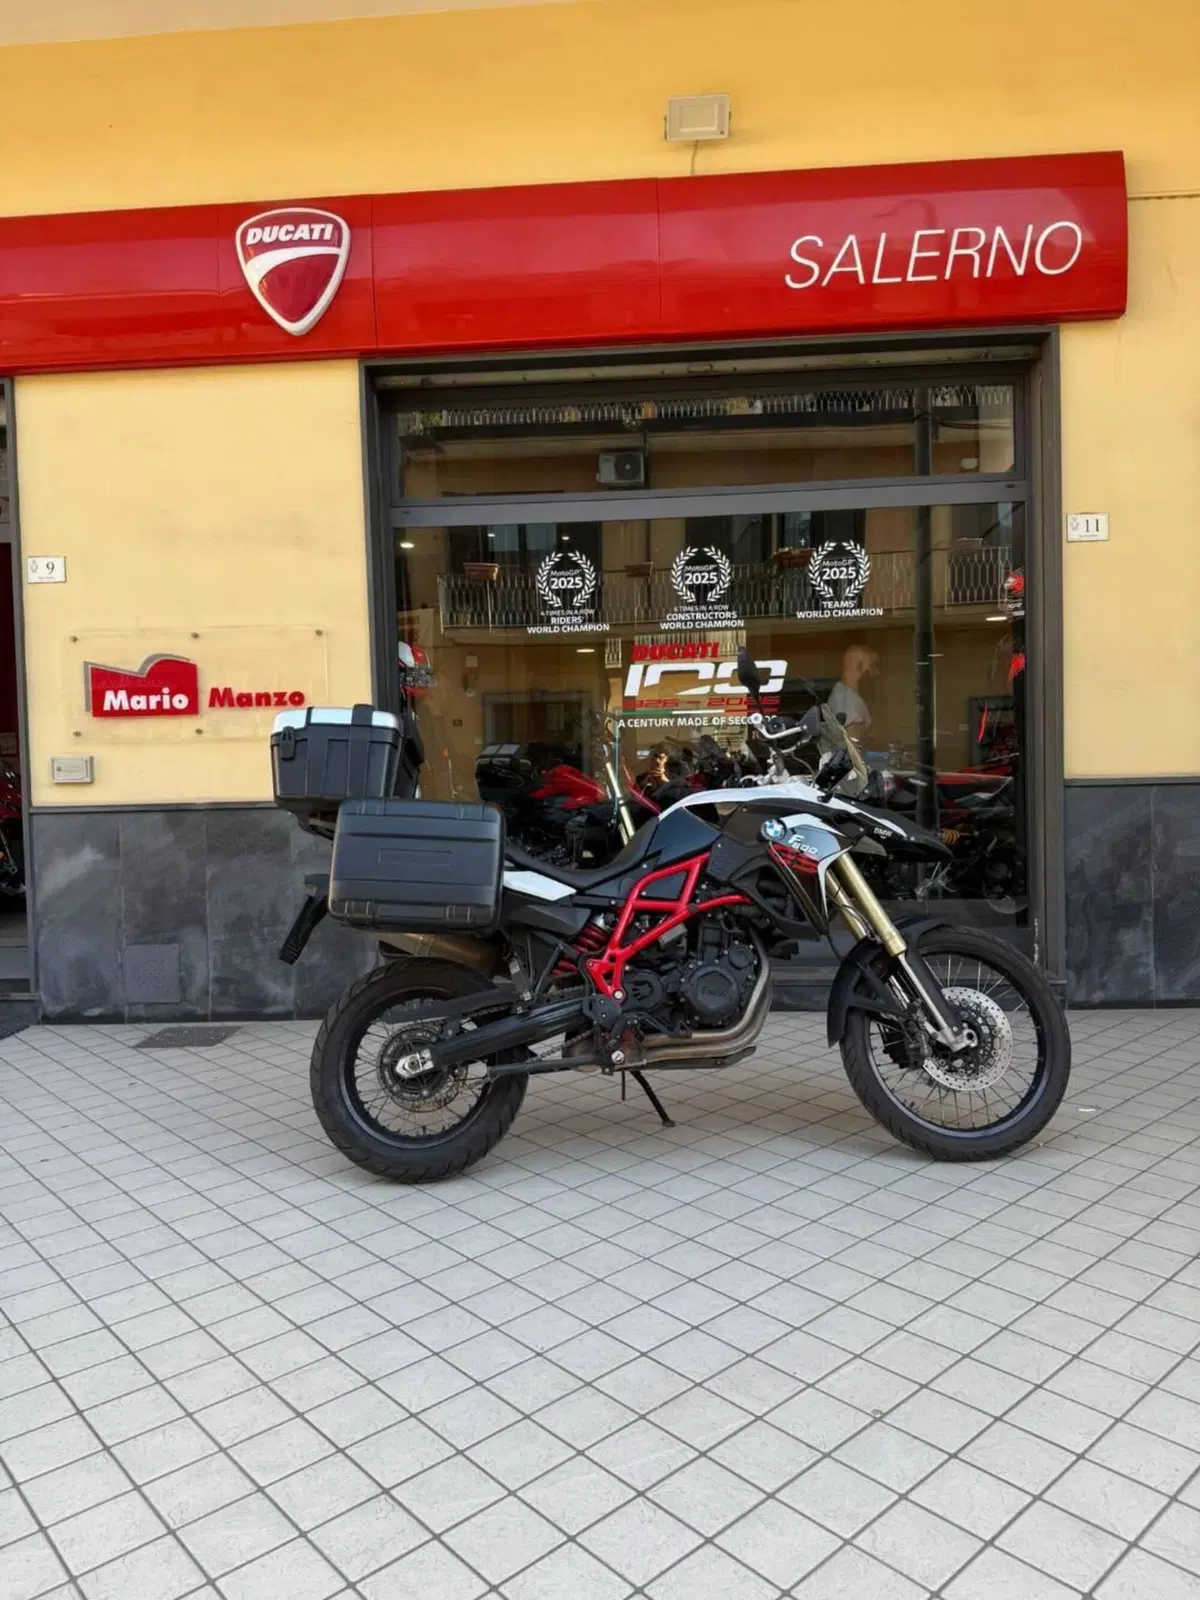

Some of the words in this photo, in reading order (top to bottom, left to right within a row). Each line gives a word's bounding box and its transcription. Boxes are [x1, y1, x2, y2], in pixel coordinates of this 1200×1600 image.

[246, 223, 333, 246] DUCATI
[784, 220, 1082, 289] SALERNO
[1085, 518, 1100, 533] 11
[46, 560, 55, 576] 9
[822, 567, 857, 580] 2025
[550, 577, 583, 589] 2025
[684, 572, 718, 584] 2025
[546, 609, 565, 617] TIMES
[666, 611, 738, 621] CONSTRUCTORS
[796, 610, 831, 619] WORLD
[832, 608, 884, 618] CHAMPION
[527, 625, 560, 634] WORLD
[561, 623, 610, 633] CHAMPION
[660, 621, 693, 630] WORLD
[695, 619, 745, 629] CHAMPION
[632, 641, 720, 661] DUCATI
[103, 687, 189, 711] Mario
[208, 687, 306, 708] Manzo
[618, 719, 626, 728] A
[627, 718, 674, 728] CENTURY
[677, 717, 710, 727] MADE
[712, 716, 726, 726] OF
[873, 827, 893, 837] BMW
